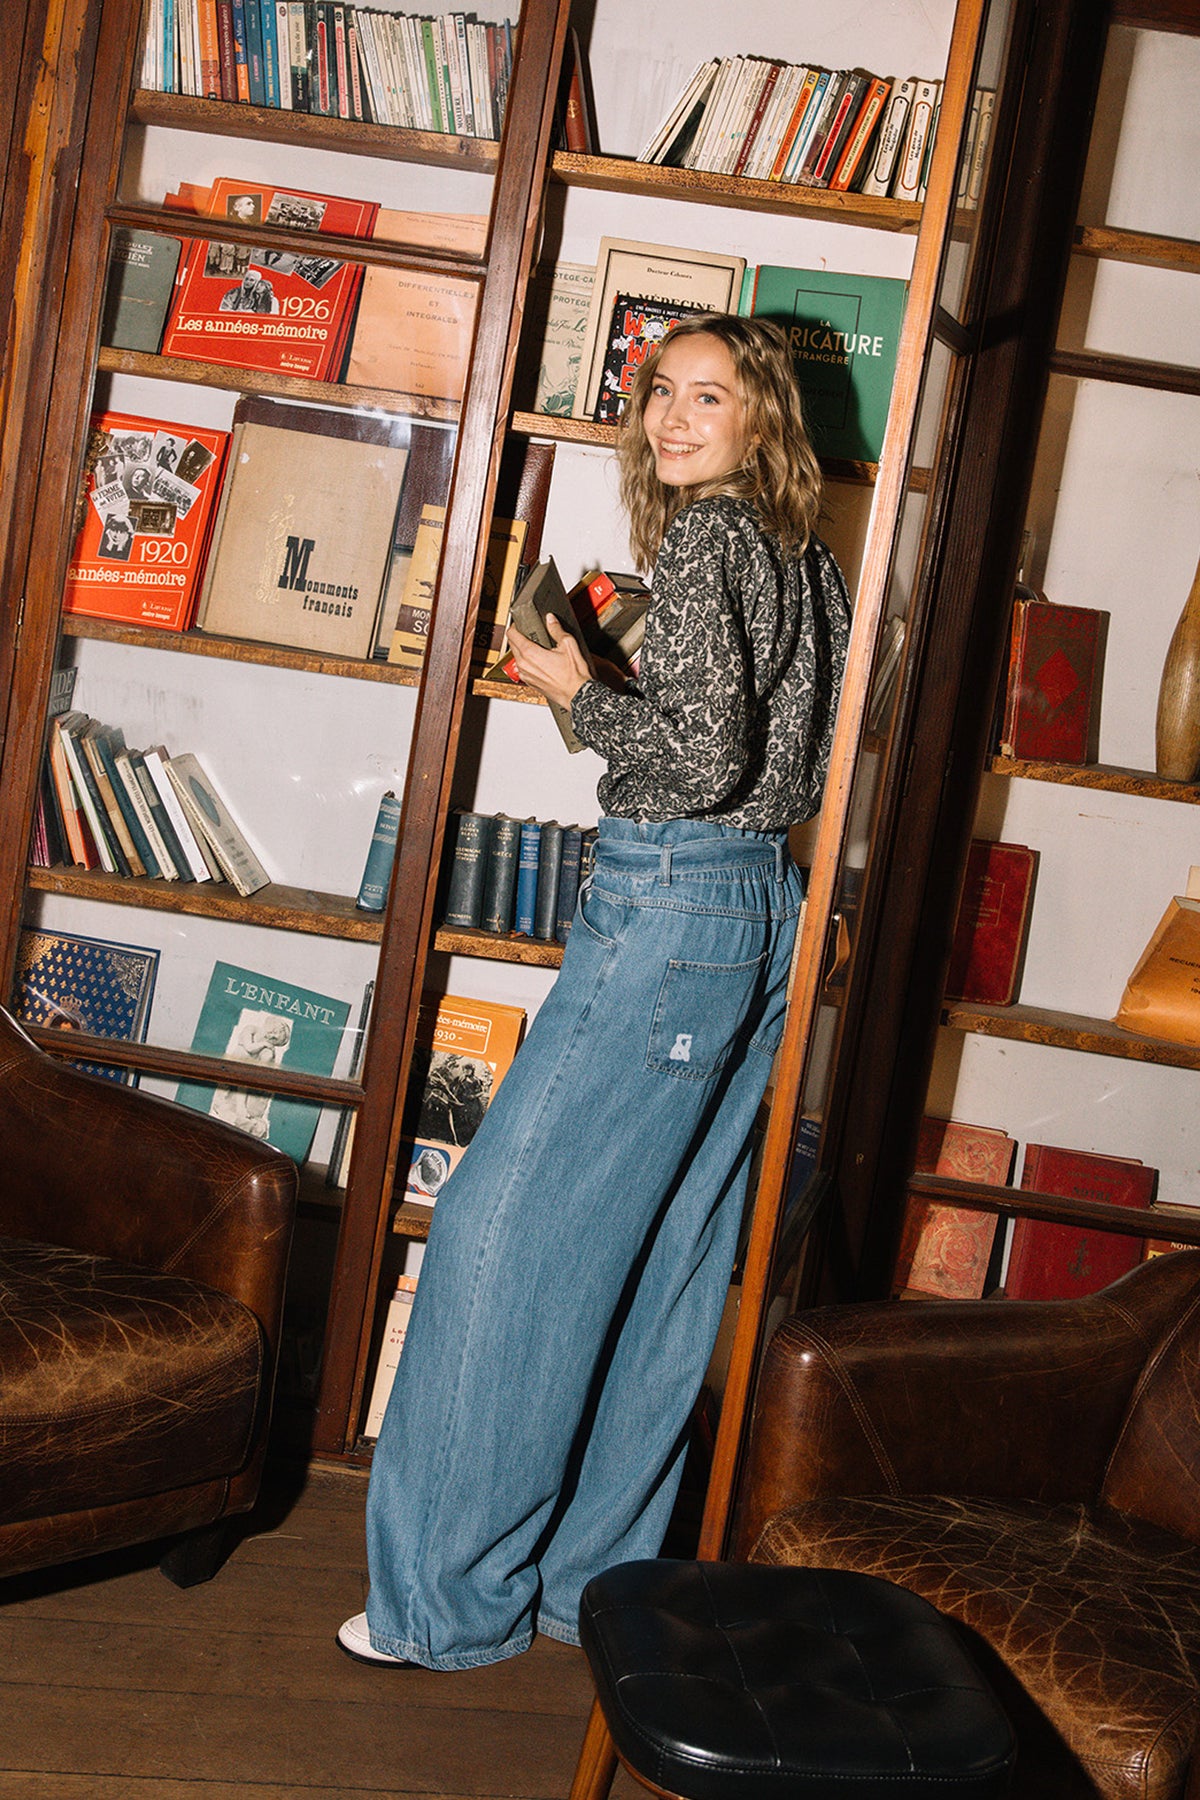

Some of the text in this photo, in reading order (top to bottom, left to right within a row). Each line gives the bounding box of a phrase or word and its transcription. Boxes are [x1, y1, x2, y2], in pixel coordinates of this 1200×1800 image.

[281, 296, 329, 320] 1926
[176, 316, 328, 340] Les années-mémoire
[140, 540, 188, 564] 1920
[69, 567, 186, 586] années-mémoire
[278, 535, 359, 600] Monuments
[303, 595, 353, 618] français
[224, 977, 335, 1025] L'ENFANT
